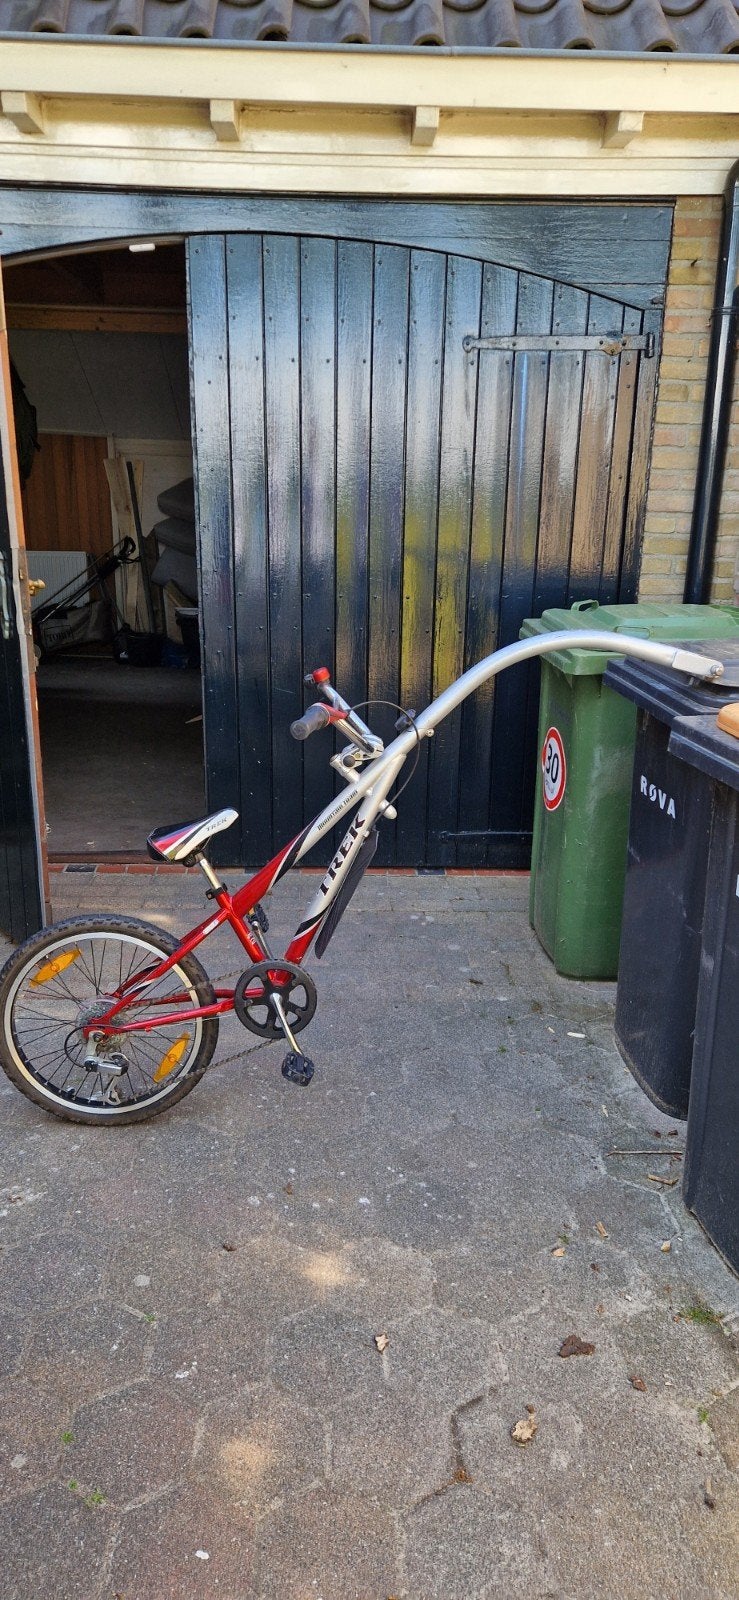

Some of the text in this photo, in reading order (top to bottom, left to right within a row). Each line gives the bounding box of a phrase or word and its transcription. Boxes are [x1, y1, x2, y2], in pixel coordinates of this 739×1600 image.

[545, 743, 560, 784] 30
[206, 816, 227, 831] TREK
[317, 812, 365, 896] TREK
